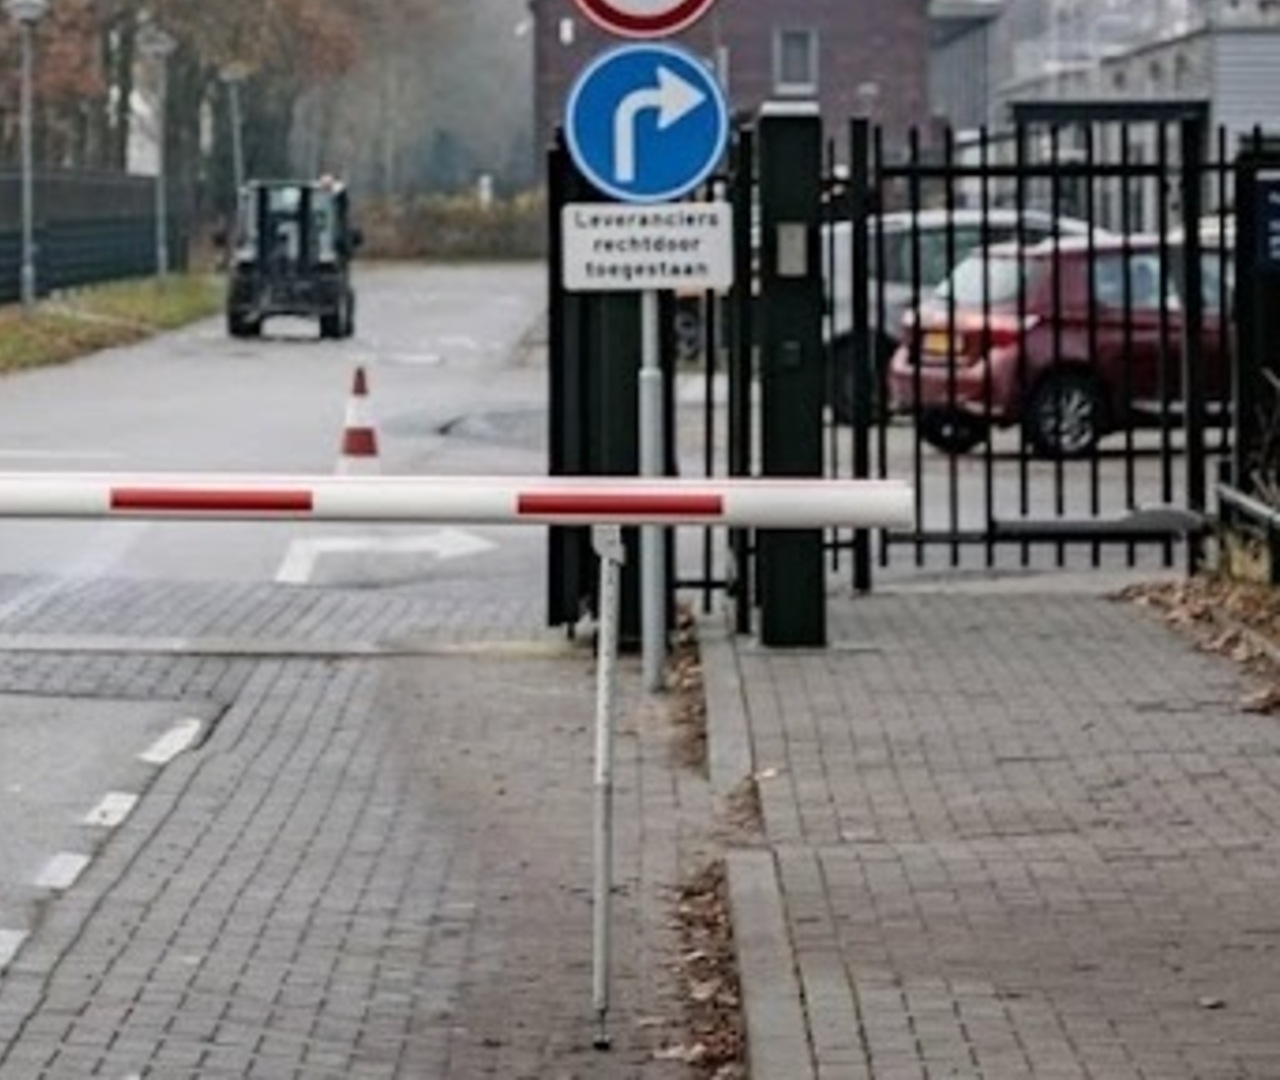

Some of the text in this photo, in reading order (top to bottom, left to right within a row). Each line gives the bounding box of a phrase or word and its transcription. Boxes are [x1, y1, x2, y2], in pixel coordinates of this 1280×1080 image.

[574, 210, 719, 228] Leveranciers
[593, 236, 700, 252] rechtdoor
[585, 262, 708, 281] toegestaan
